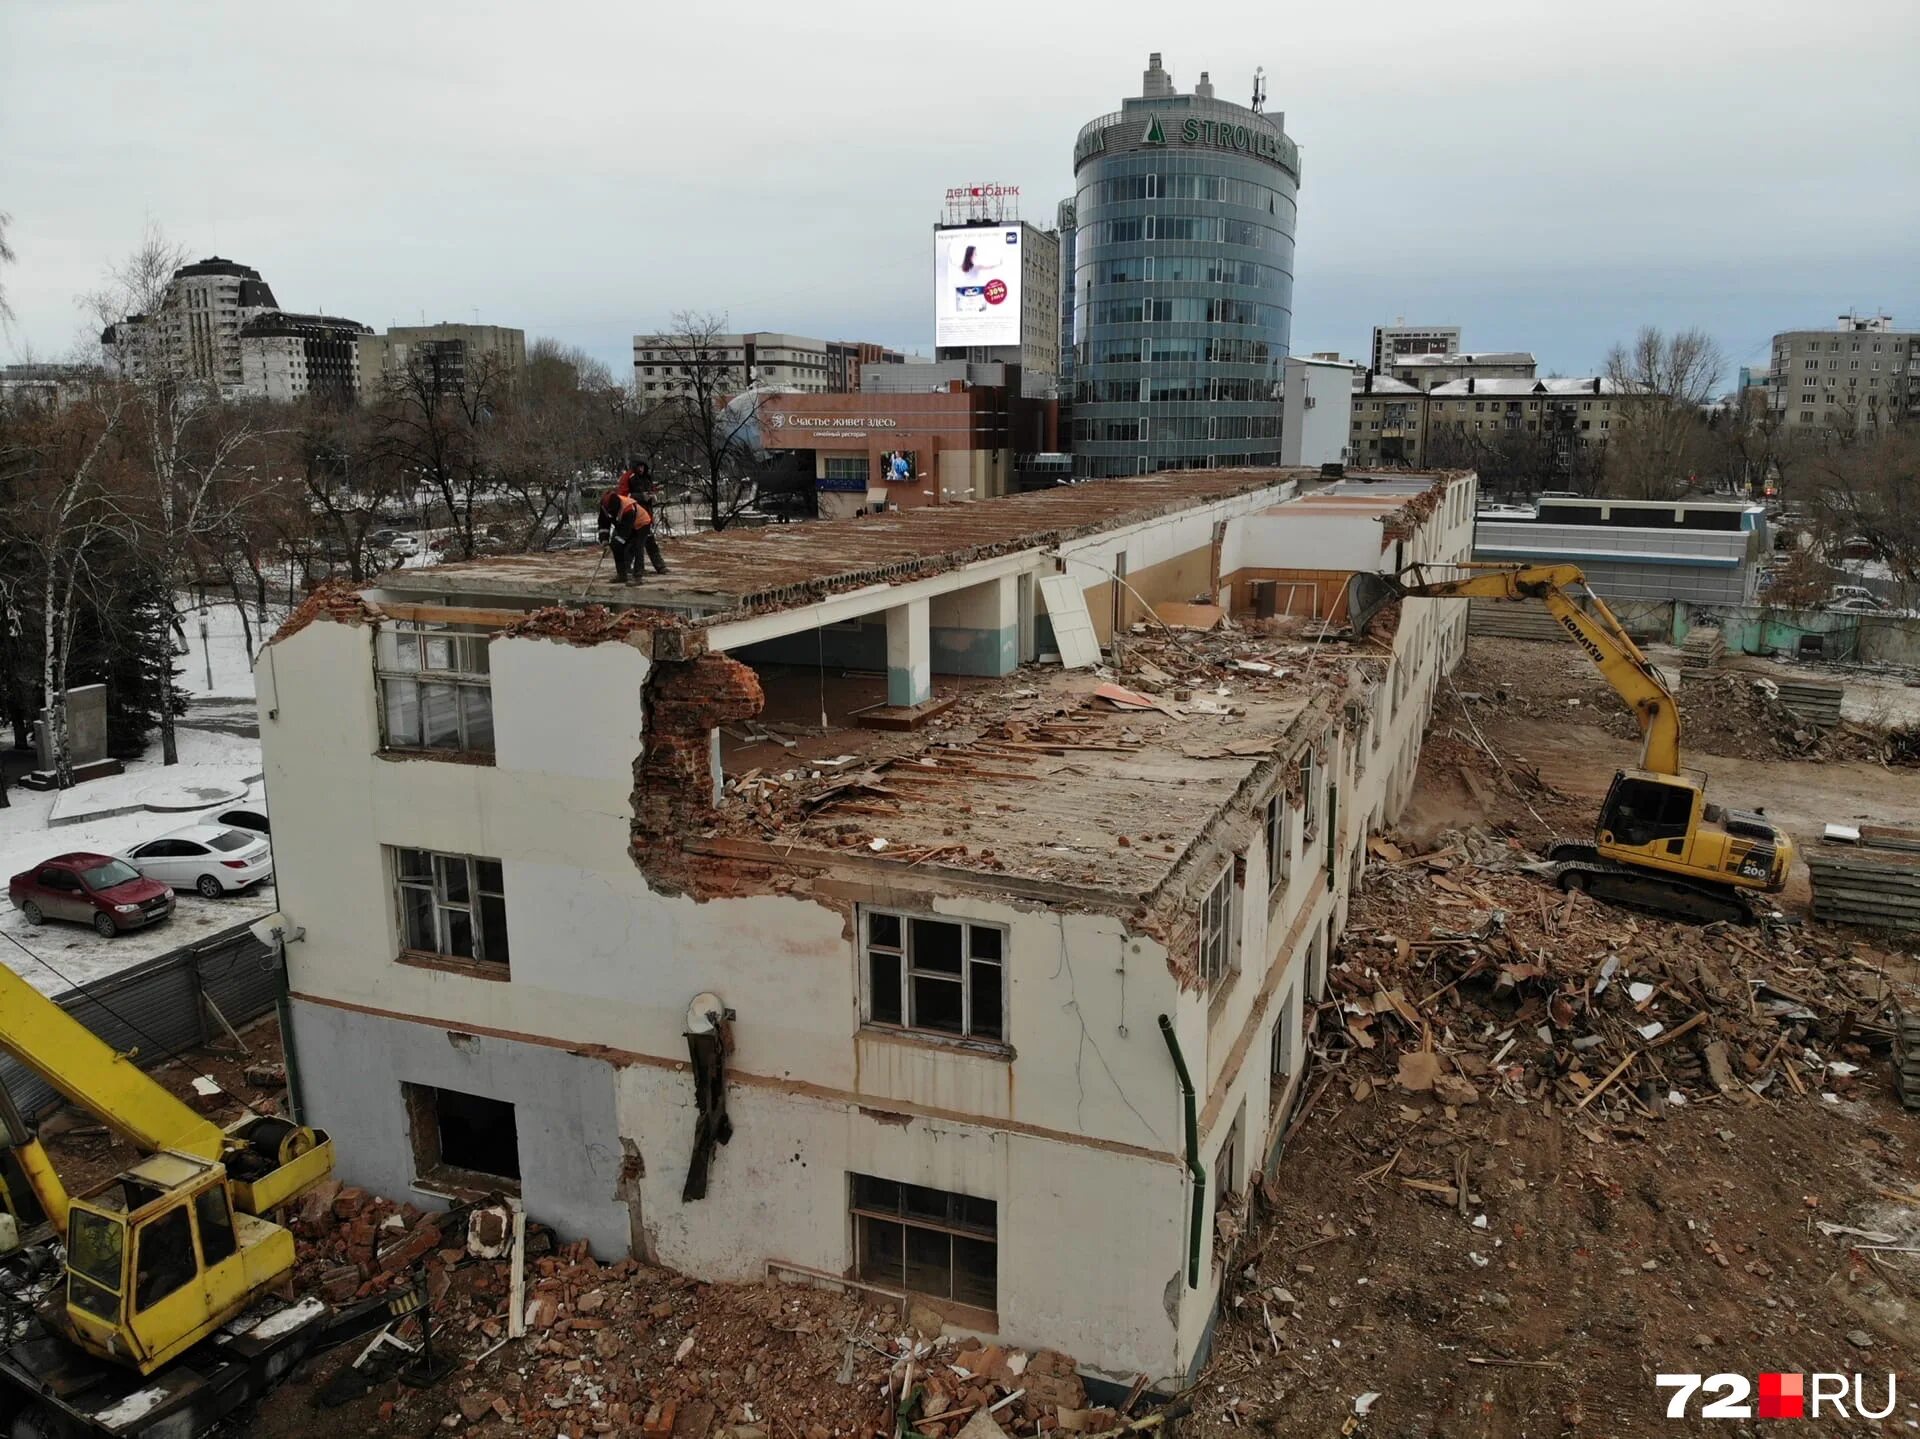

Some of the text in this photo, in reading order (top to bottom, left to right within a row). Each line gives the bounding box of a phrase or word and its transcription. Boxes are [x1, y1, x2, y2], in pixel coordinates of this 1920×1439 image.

[789, 415, 896, 427] Счастье живет здесь
[1561, 614, 1604, 662] KOMATSU
[1743, 866, 1766, 877] 200
